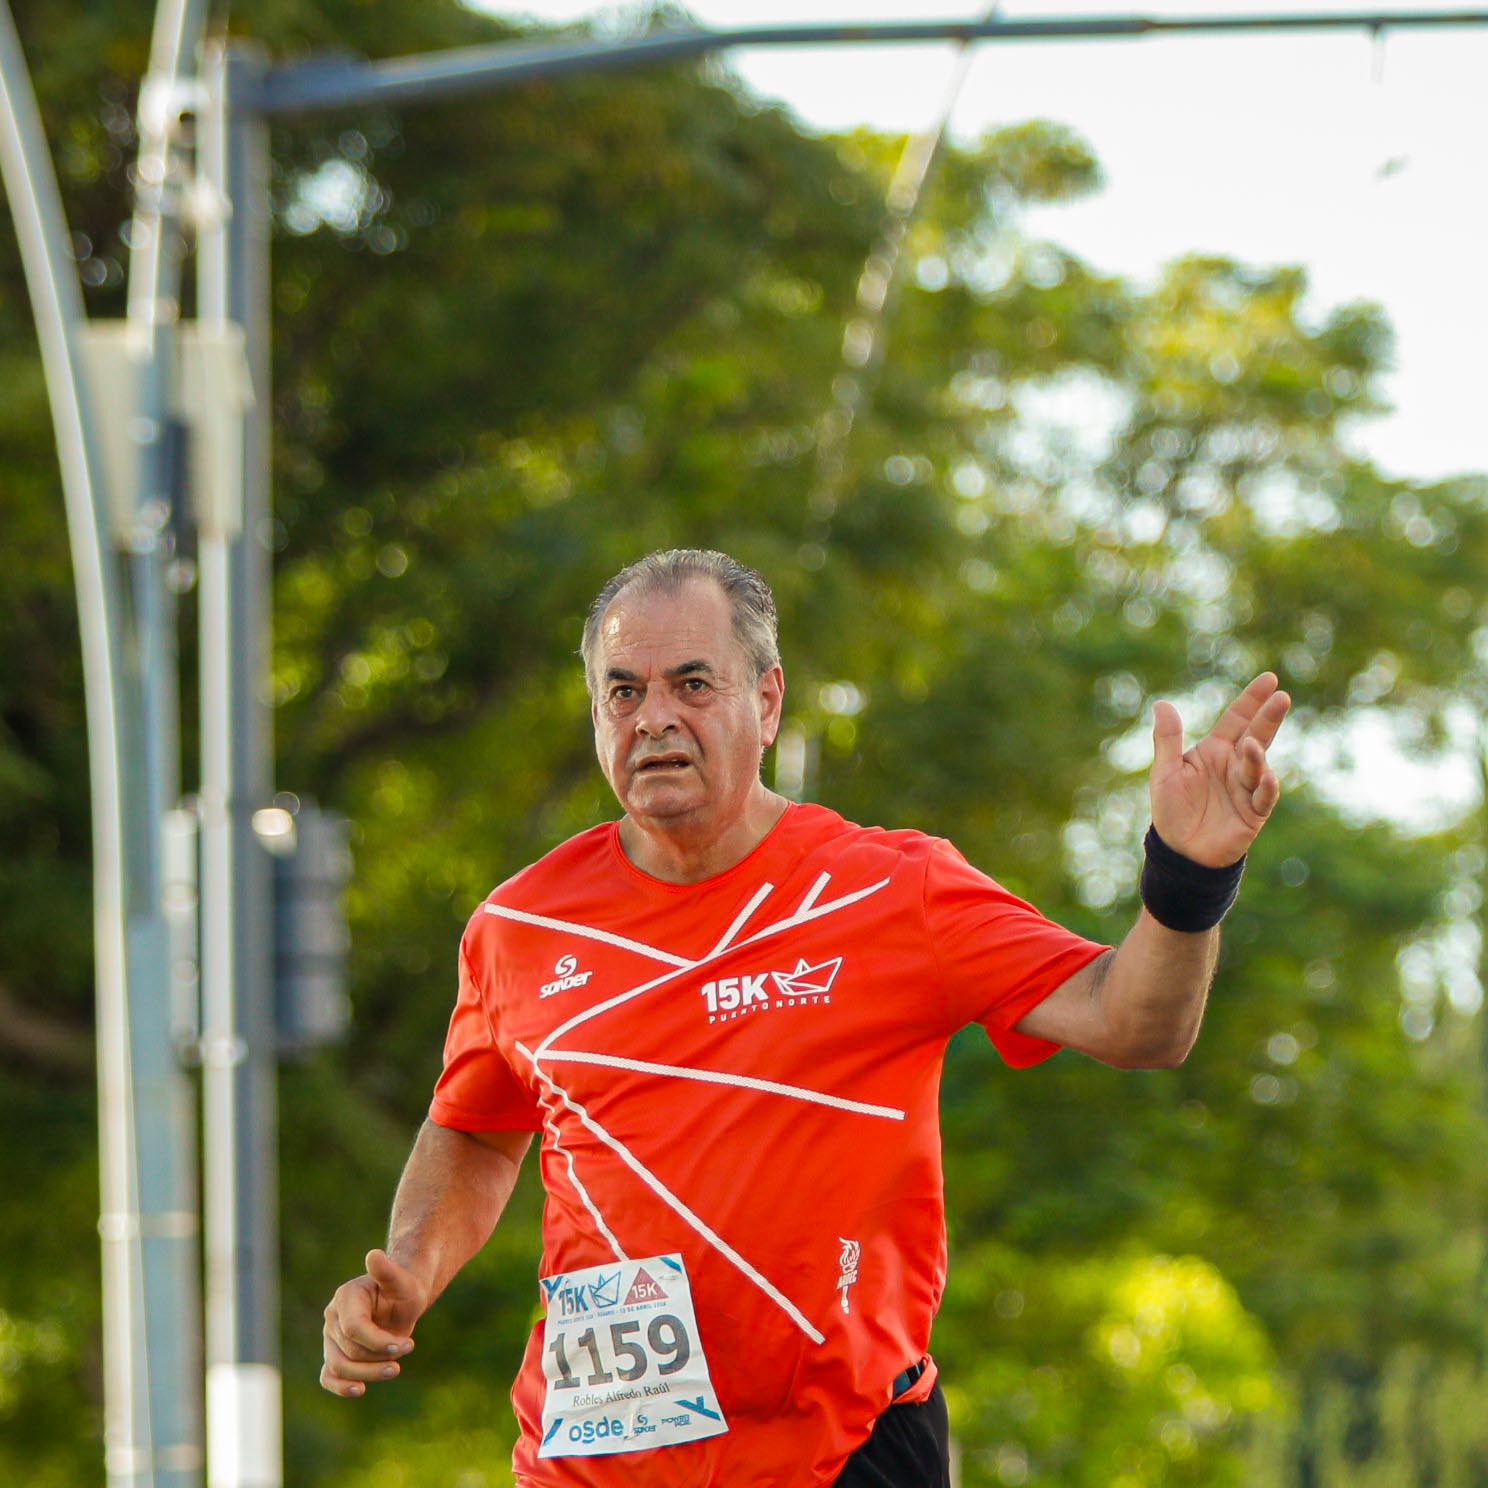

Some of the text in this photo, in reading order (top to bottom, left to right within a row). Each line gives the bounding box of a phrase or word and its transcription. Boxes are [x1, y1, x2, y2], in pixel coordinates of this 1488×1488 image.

[701, 972, 769, 1012] 15K
[709, 996, 831, 1024] PUERTO NORTE
[558, 1284, 588, 1316] 15K
[632, 1281, 658, 1299] 15K
[549, 1314, 690, 1390] 1159
[572, 1382, 670, 1408] Robles Alfredo Raúl
[569, 1416, 624, 1443] osde
